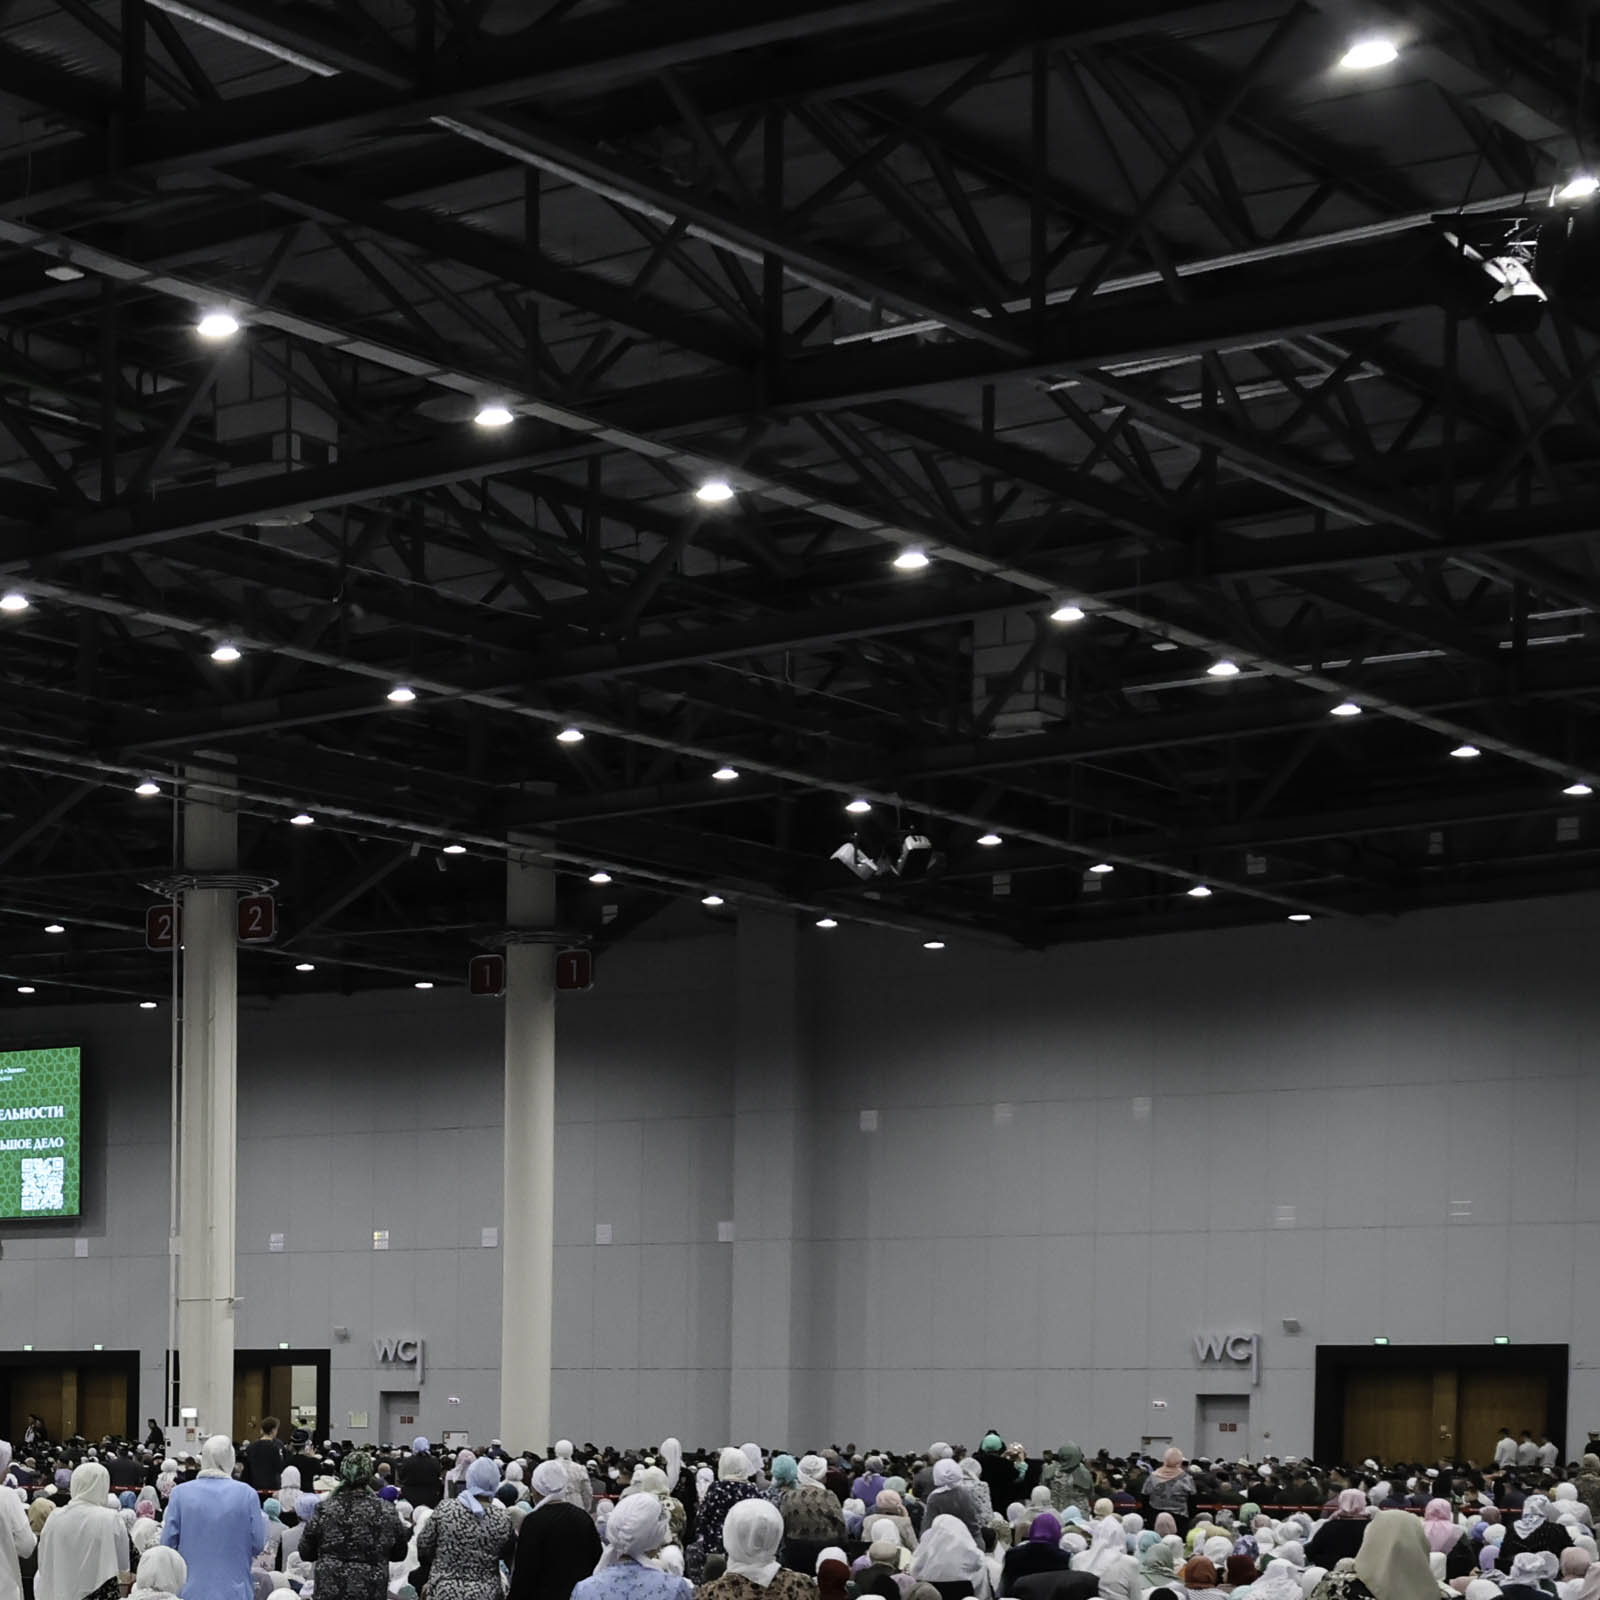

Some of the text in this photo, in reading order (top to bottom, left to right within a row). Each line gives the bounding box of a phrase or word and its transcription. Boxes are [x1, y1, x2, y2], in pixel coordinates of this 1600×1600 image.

[157, 914, 171, 940] 2
[248, 905, 262, 931] 2
[569, 959, 577, 983] 1
[33, 1136, 64, 1151] ДЕЛО
[375, 1337, 417, 1361] WC
[1193, 1336, 1250, 1360] WC
